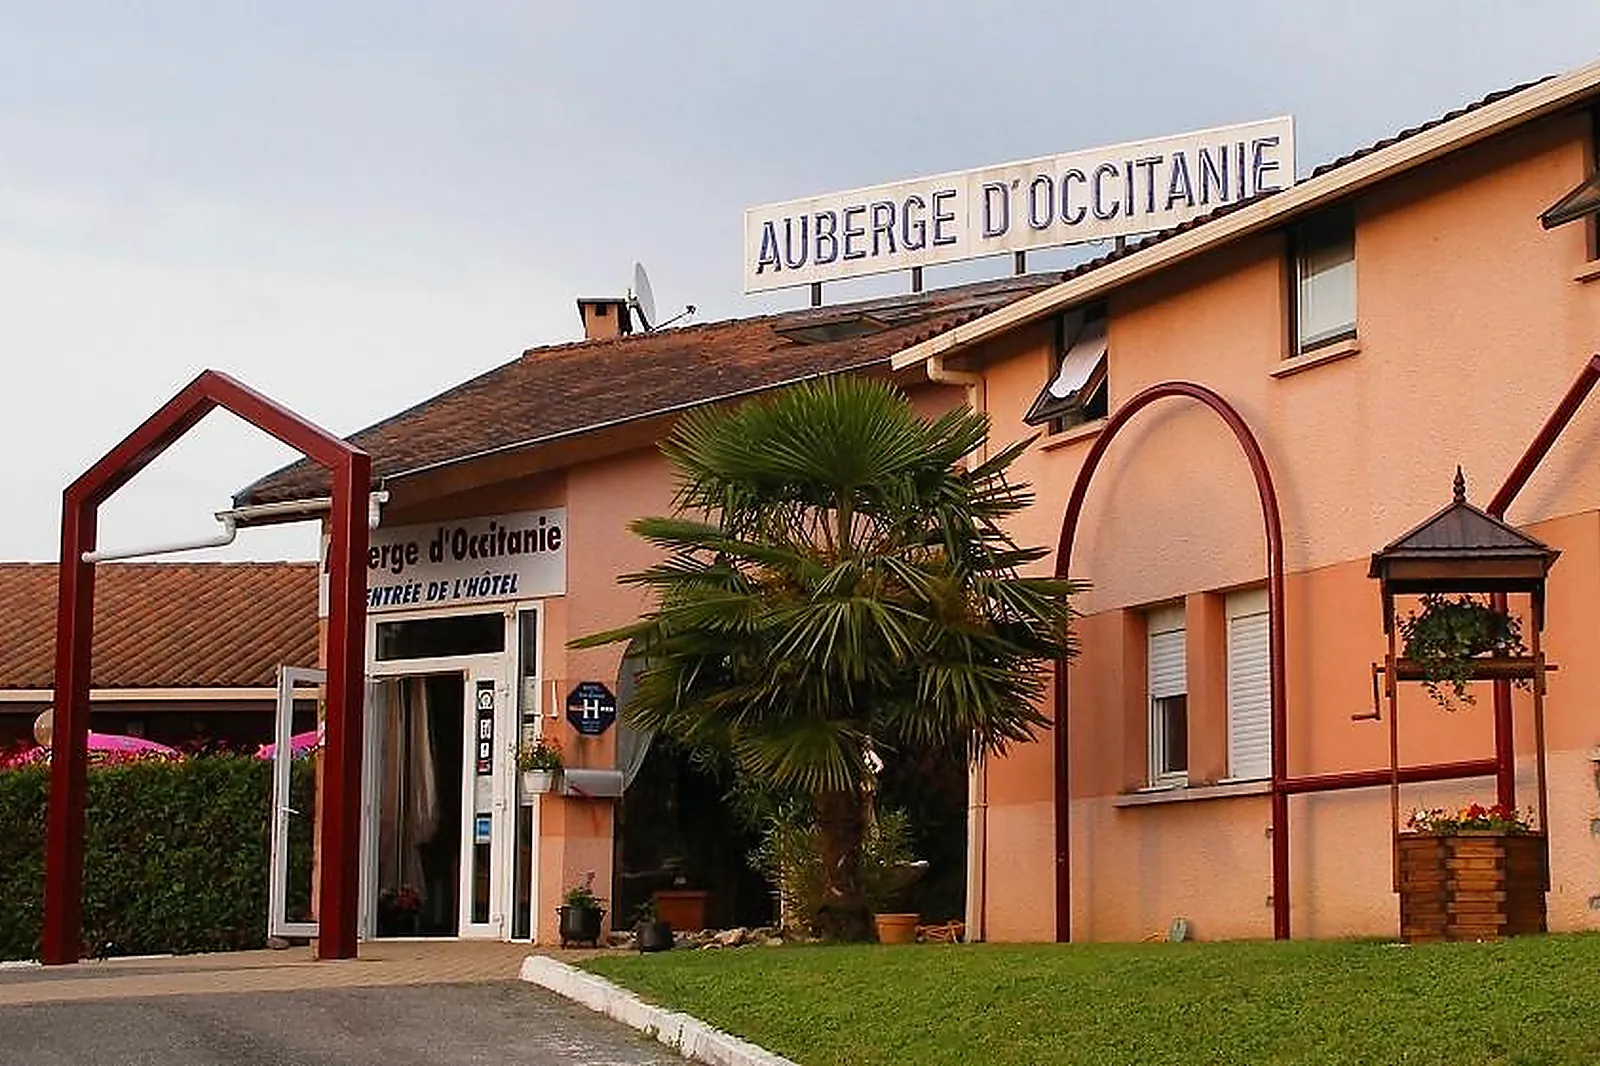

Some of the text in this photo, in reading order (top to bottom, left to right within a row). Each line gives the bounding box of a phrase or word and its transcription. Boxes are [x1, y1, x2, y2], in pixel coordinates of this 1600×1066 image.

[756, 135, 1280, 274] AUBERGE D'OCCITANIE
[324, 516, 562, 574] erge d'Occitanie
[427, 581, 449, 601] DE
[453, 569, 518, 599] L'HÔTEL
[582, 698, 600, 719] H
